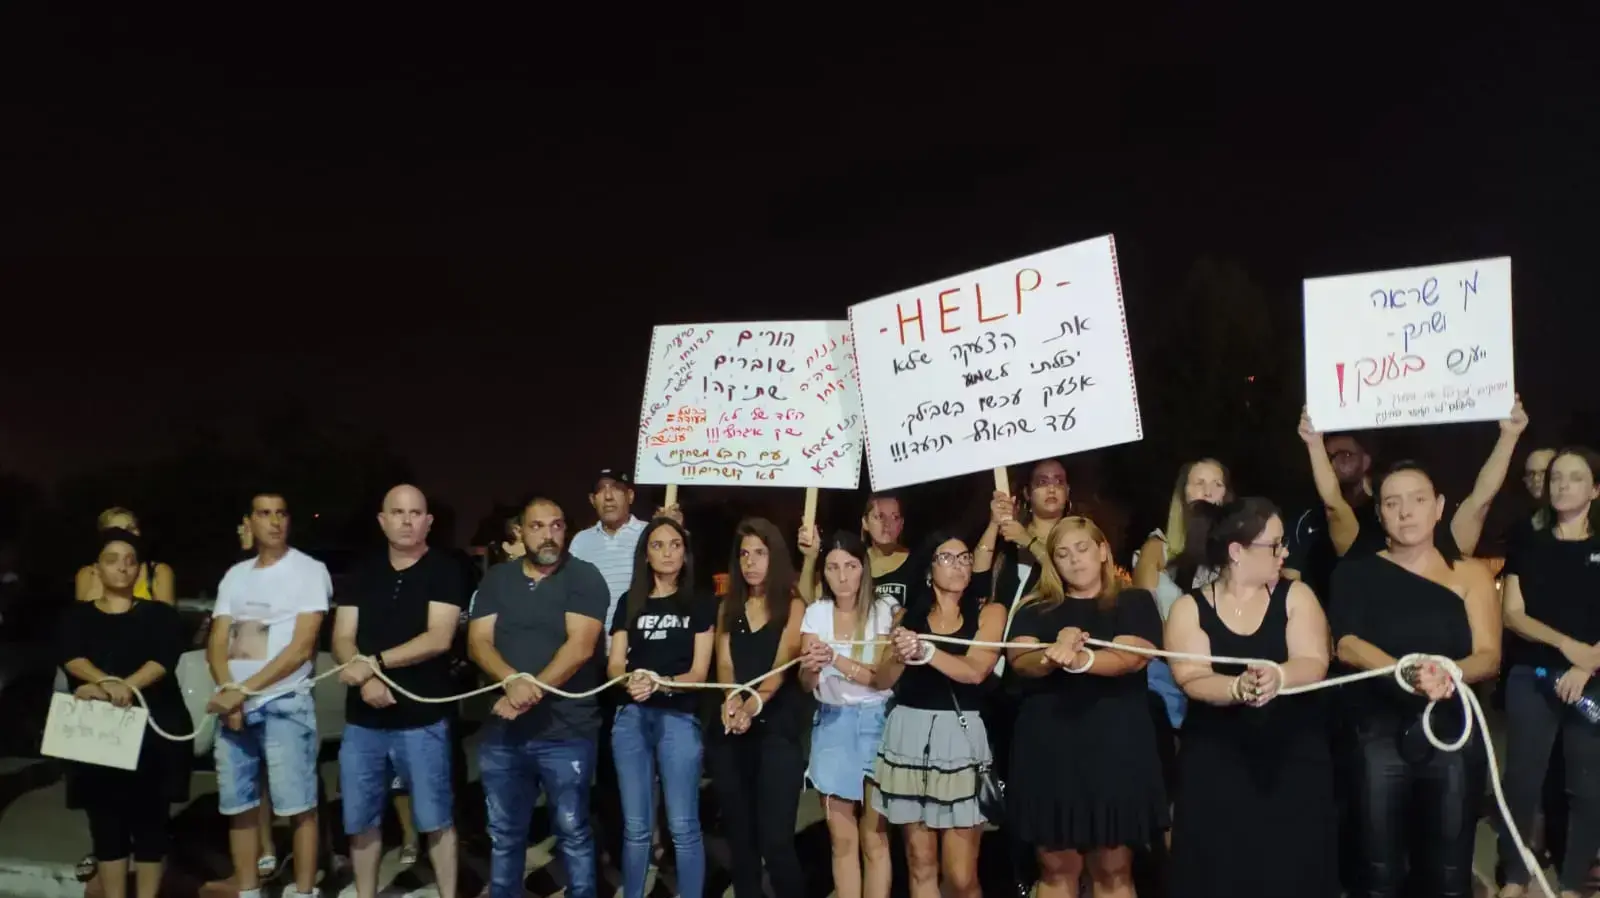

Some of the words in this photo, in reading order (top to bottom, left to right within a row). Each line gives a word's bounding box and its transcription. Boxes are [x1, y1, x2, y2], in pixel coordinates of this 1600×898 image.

[1370, 276, 1440, 310] שראה
[1459, 269, 1479, 312] מי
[738, 329, 796, 347] הורים
[1042, 315, 1091, 344] את
[1403, 311, 1448, 353] ושתק
[806, 336, 837, 369] ננוח
[950, 331, 1017, 367] הצעקה
[714, 355, 795, 373] שוברים
[893, 350, 933, 376] שלא
[1043, 375, 1096, 407] אזעק
[719, 407, 743, 425] לא
[776, 408, 805, 421] הילד
[1043, 408, 1077, 432] עד
[716, 448, 747, 459] חבל
[760, 449, 782, 461] עם
[755, 468, 784, 480] לא
